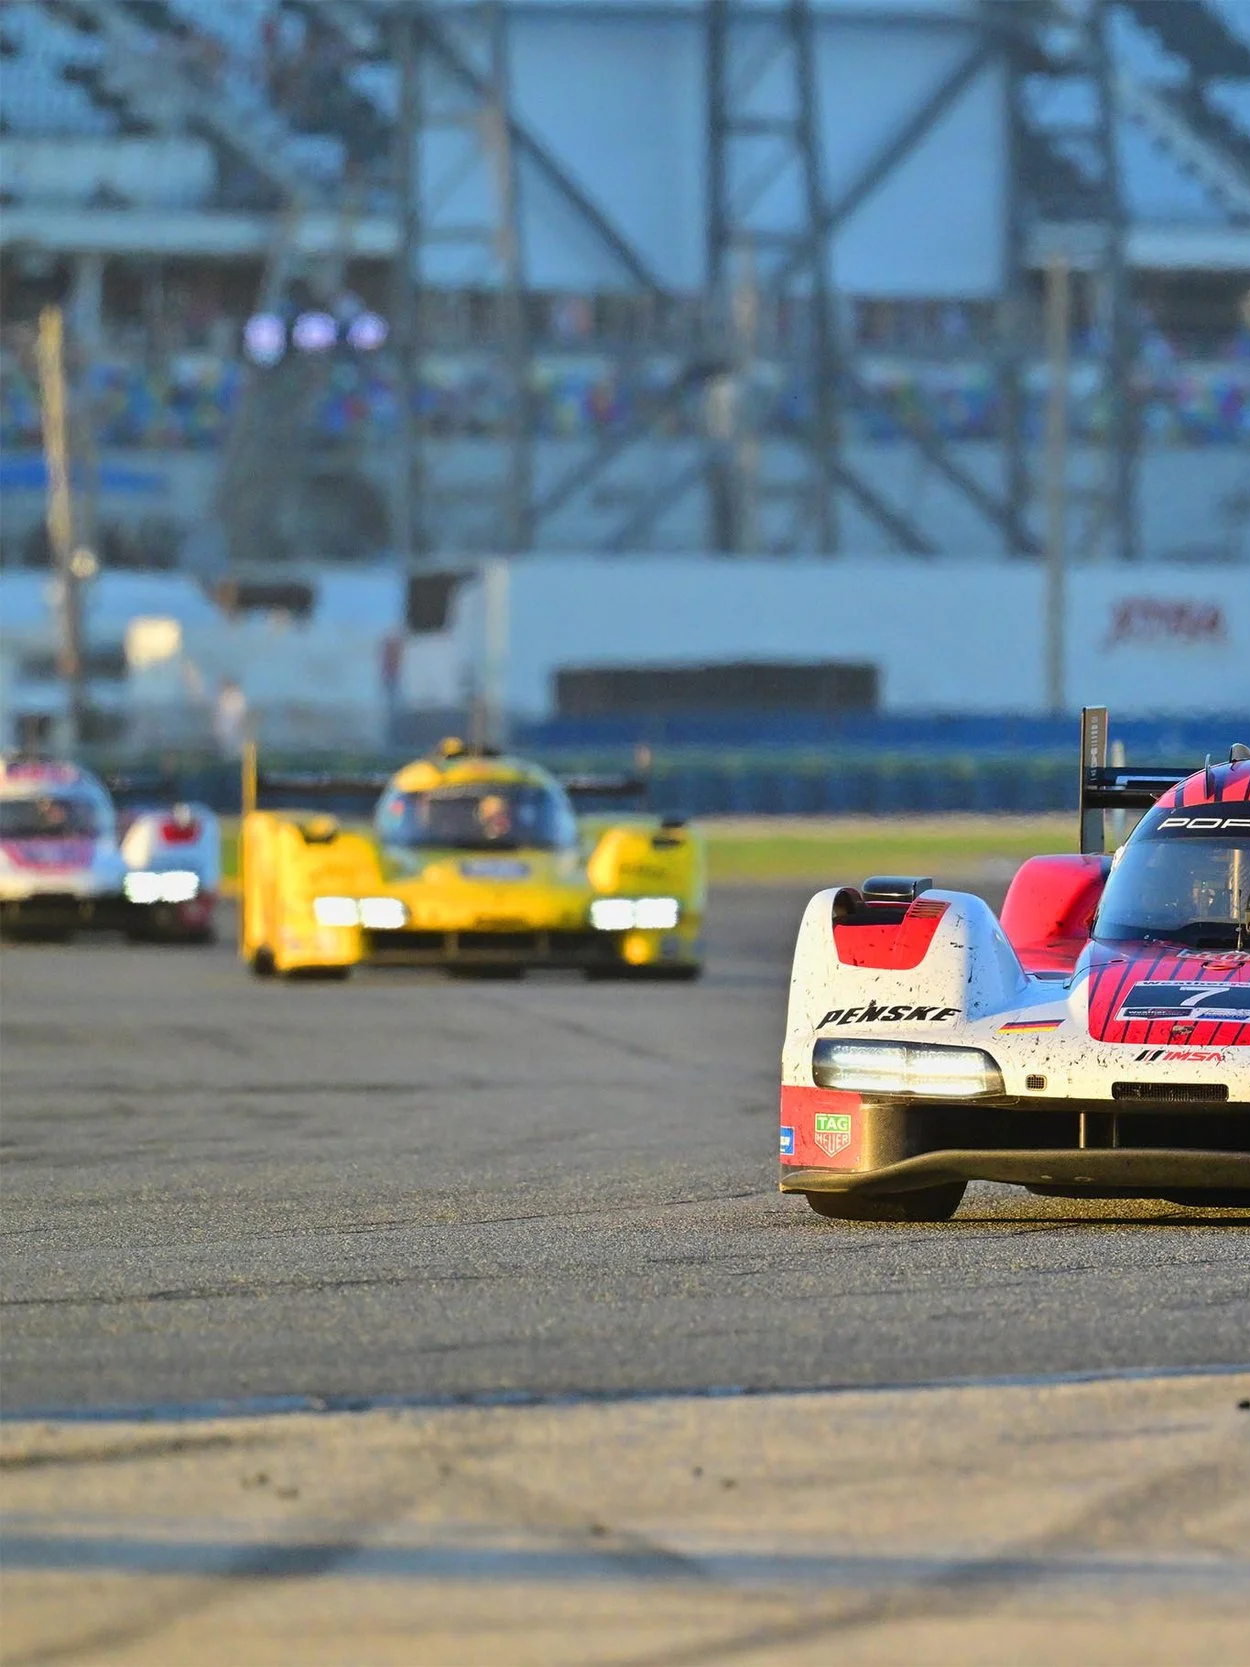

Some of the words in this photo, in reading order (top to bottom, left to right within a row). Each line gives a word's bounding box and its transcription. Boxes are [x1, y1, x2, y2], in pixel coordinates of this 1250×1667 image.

[1178, 986, 1231, 1007] 7
[815, 1005, 962, 1031] PENSKE
[1162, 1051, 1223, 1062] IMSA
[817, 1116, 848, 1130] TAG
[815, 1132, 849, 1154] HEUER
